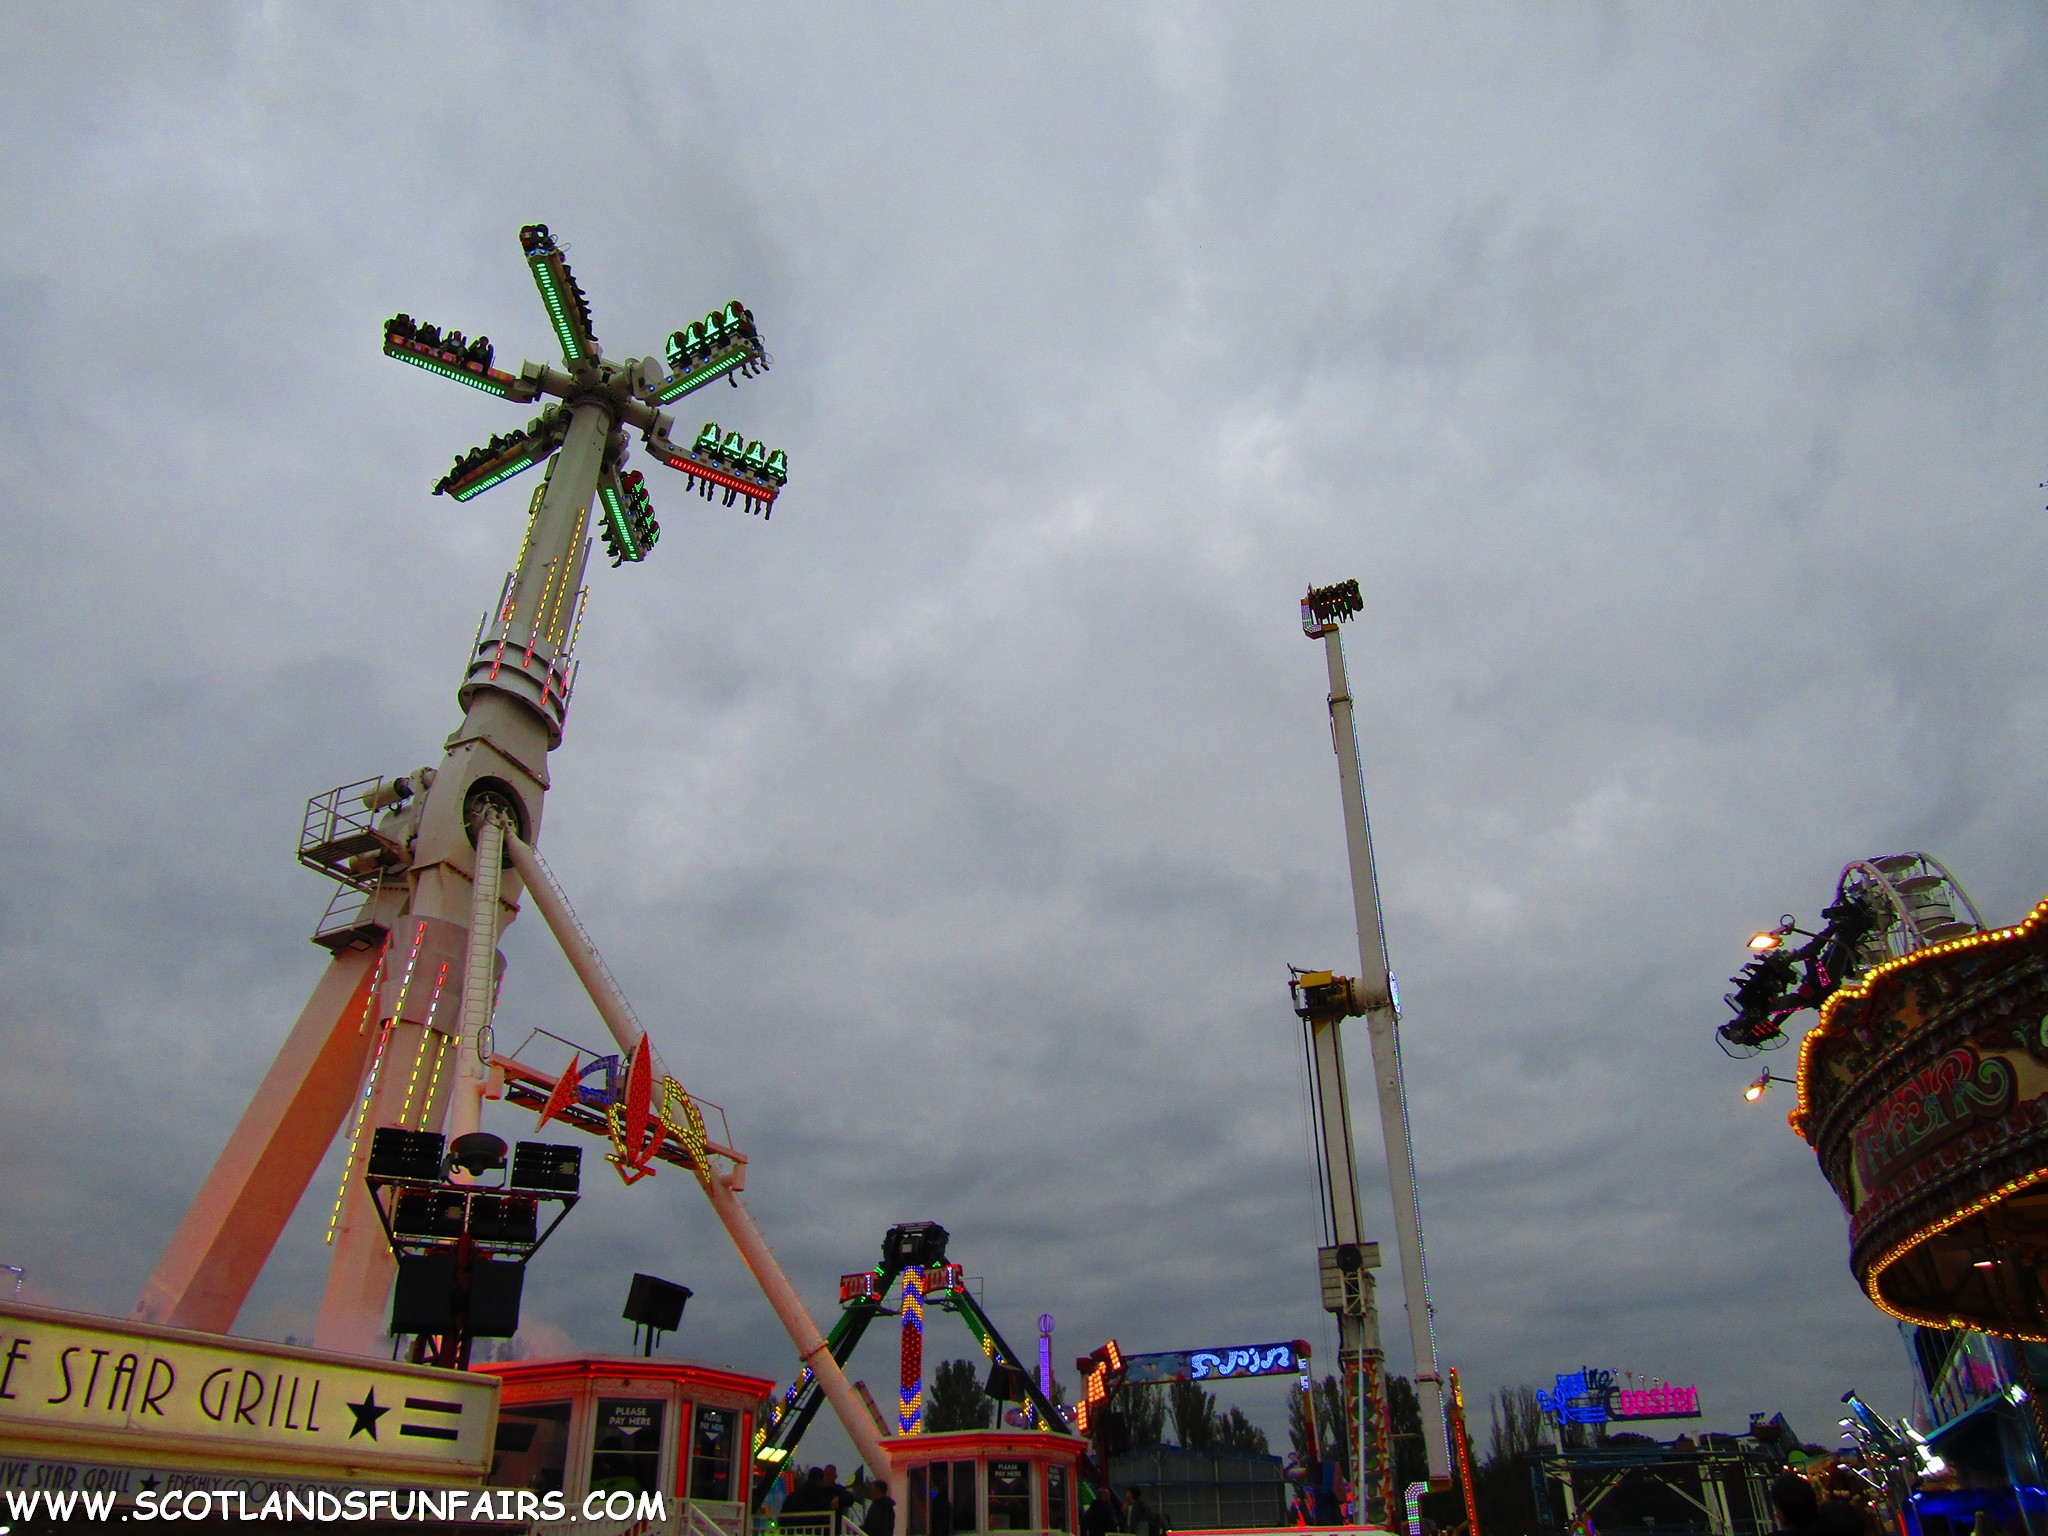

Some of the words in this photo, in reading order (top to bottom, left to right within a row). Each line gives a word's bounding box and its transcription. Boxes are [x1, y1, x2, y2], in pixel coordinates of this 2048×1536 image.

[48, 1346, 175, 1416] STAR
[200, 1367, 319, 1432] GRILL
[1604, 1382, 1697, 1418] Coaster
[609, 1416, 626, 1425] PAY
[629, 1416, 652, 1426] HERE
[615, 1406, 647, 1416] PLEASE
[32, 1464, 77, 1490] STAR
[84, 1468, 130, 1493] GRILL
